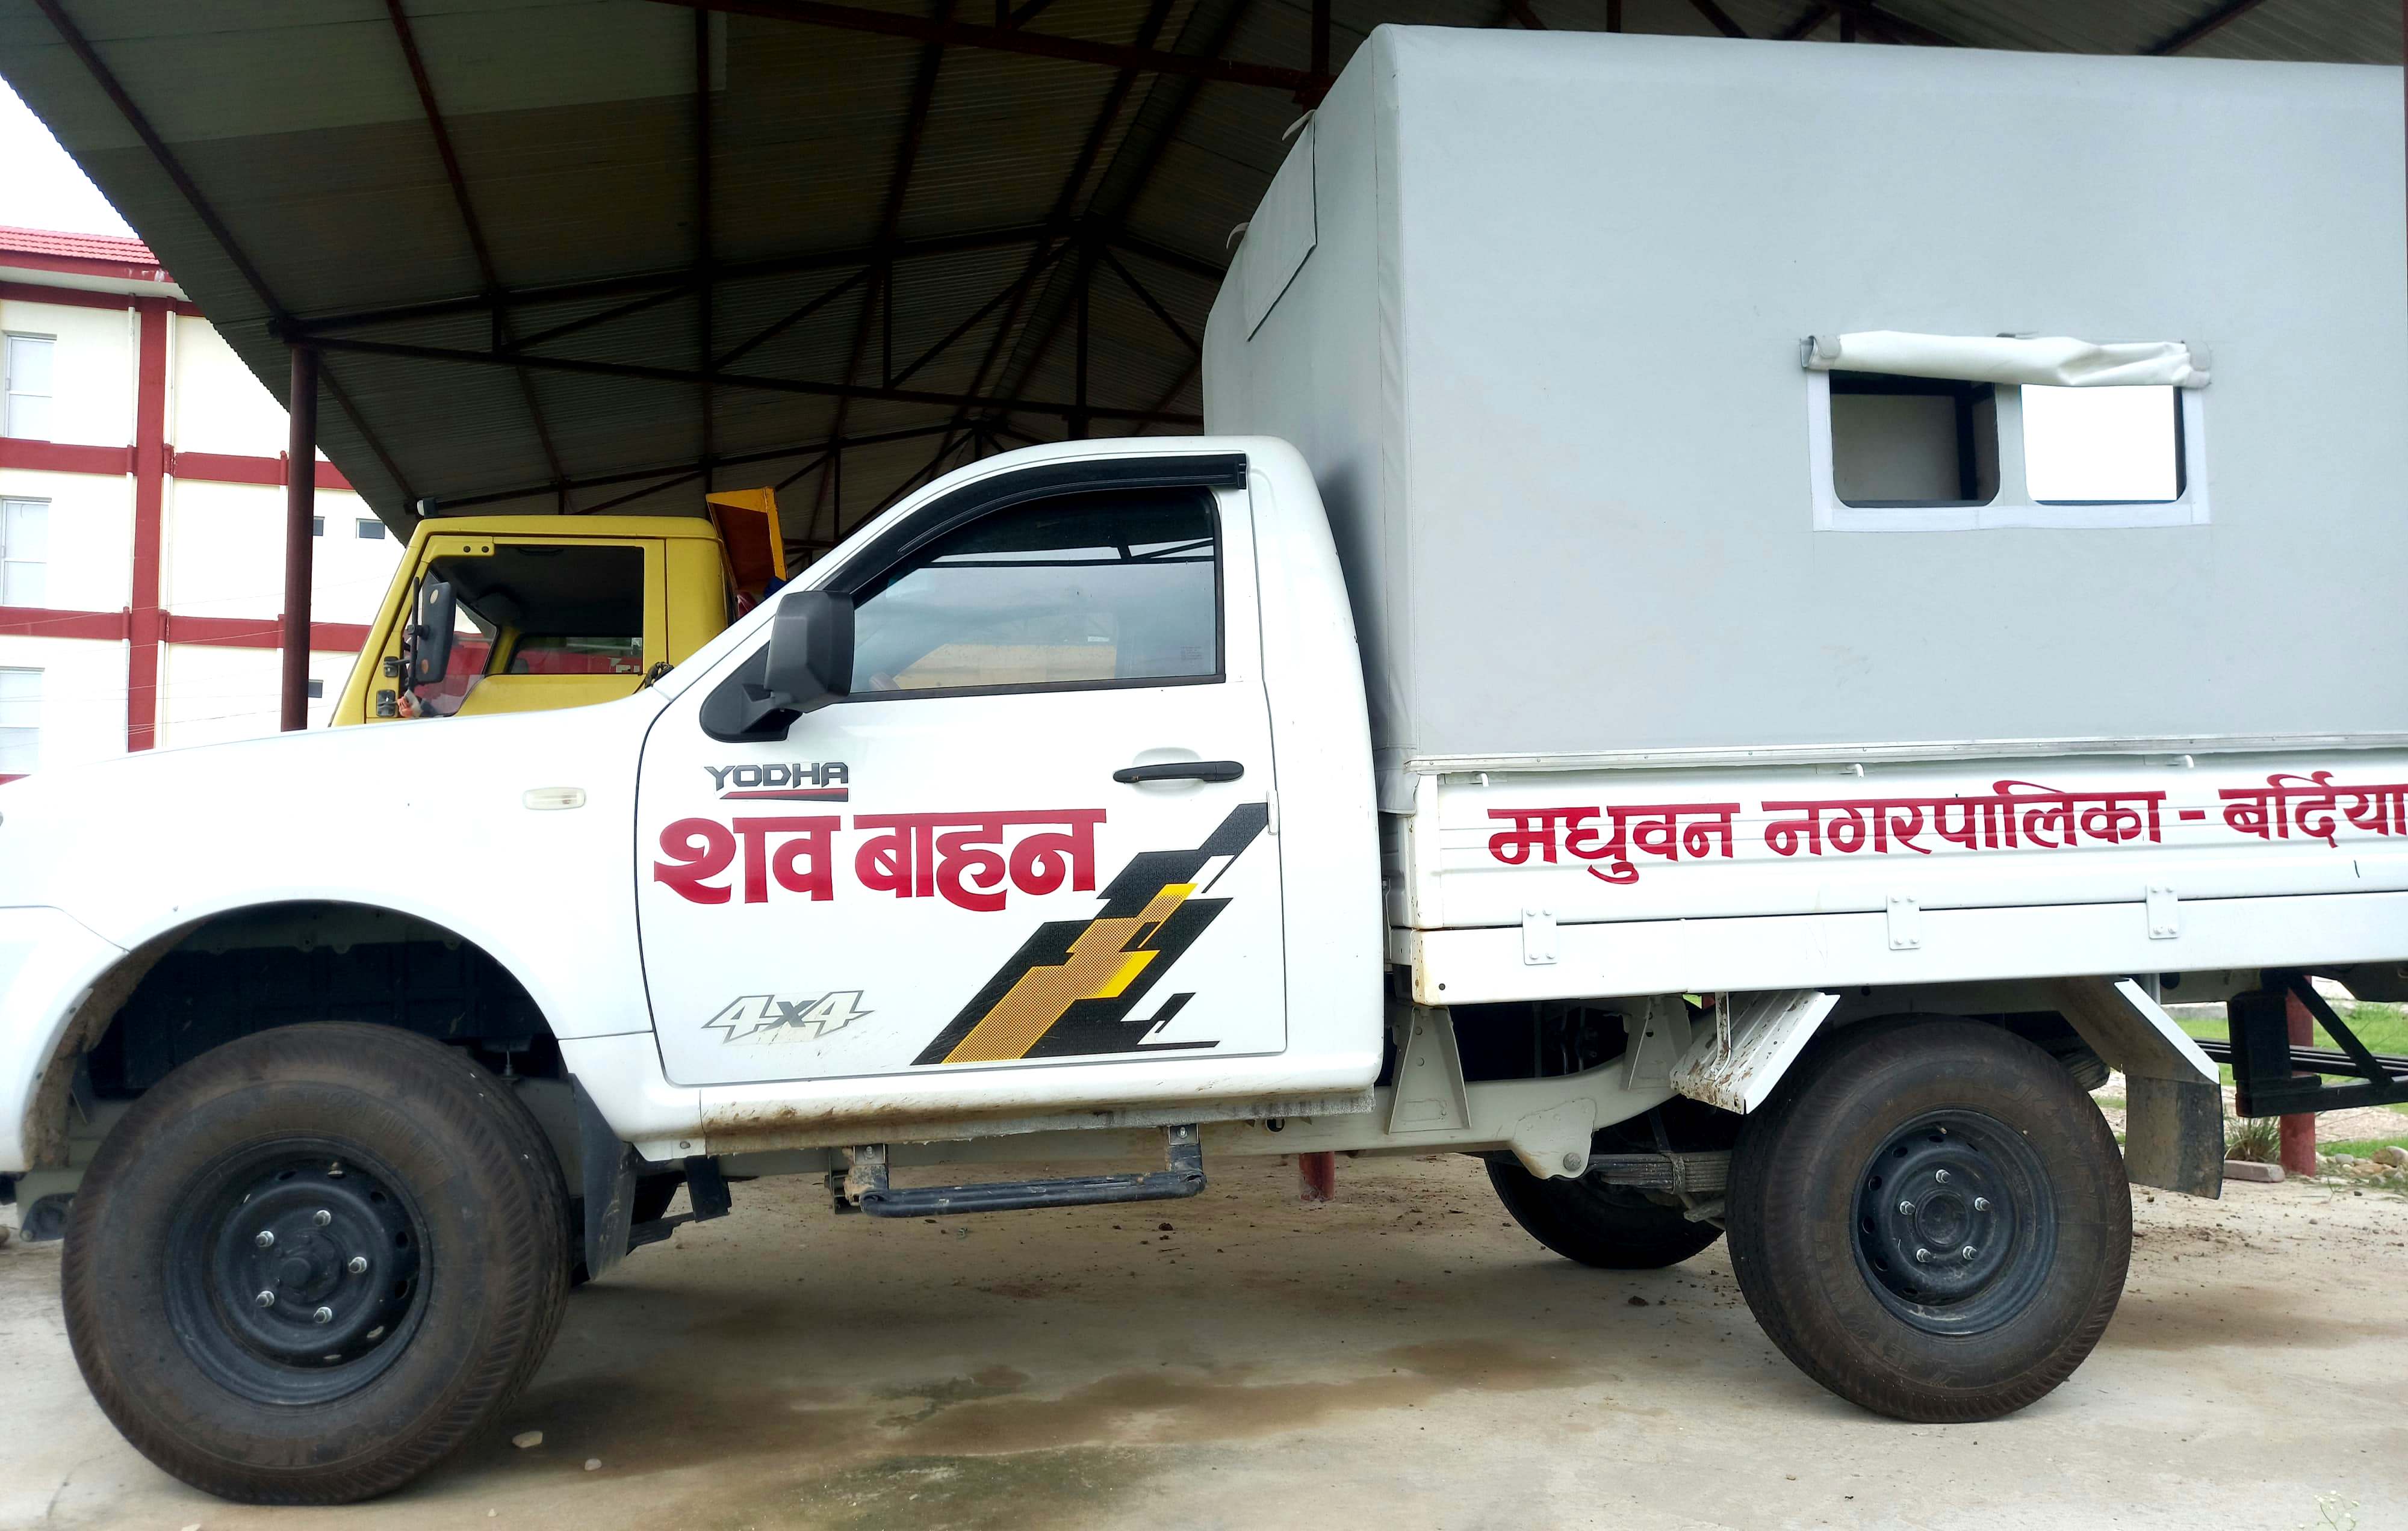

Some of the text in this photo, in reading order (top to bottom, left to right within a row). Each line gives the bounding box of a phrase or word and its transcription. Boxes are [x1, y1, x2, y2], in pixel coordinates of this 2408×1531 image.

[703, 762, 849, 791] YODHA
[1487, 802, 1741, 885] मधुवन
[1761, 780, 2167, 857] नगरपालिका
[2218, 770, 2408, 849] बर्दिया
[654, 808, 1107, 913] शव बाहन
